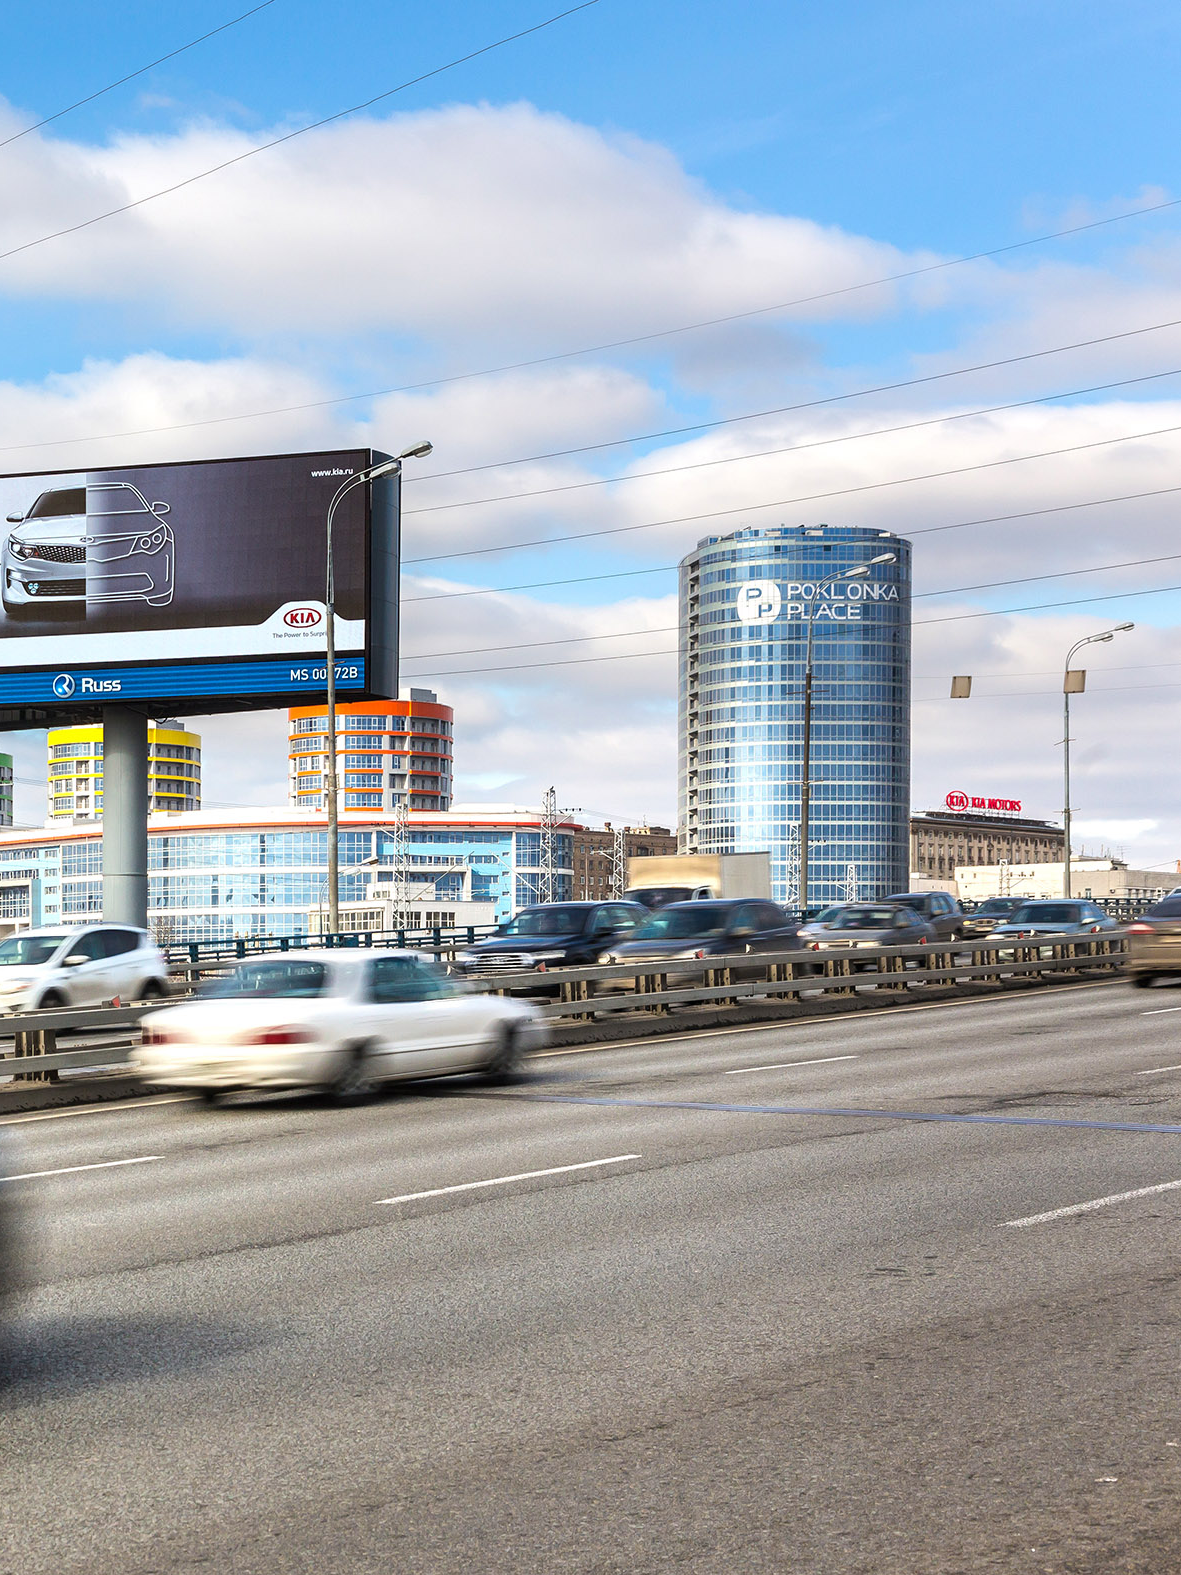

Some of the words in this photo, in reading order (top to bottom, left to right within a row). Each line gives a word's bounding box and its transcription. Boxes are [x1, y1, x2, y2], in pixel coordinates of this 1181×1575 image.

[311, 468, 353, 477] www.kia.ru
[787, 583, 900, 601] POKLONKA
[290, 612, 315, 624] KIA
[787, 603, 861, 620] PLACE
[310, 630, 327, 638] Surpri
[290, 669, 309, 681] MS
[312, 666, 358, 680] 0072B
[81, 677, 122, 693] Russ
[971, 797, 986, 809] KIA
[988, 798, 1022, 811] MOTORS
